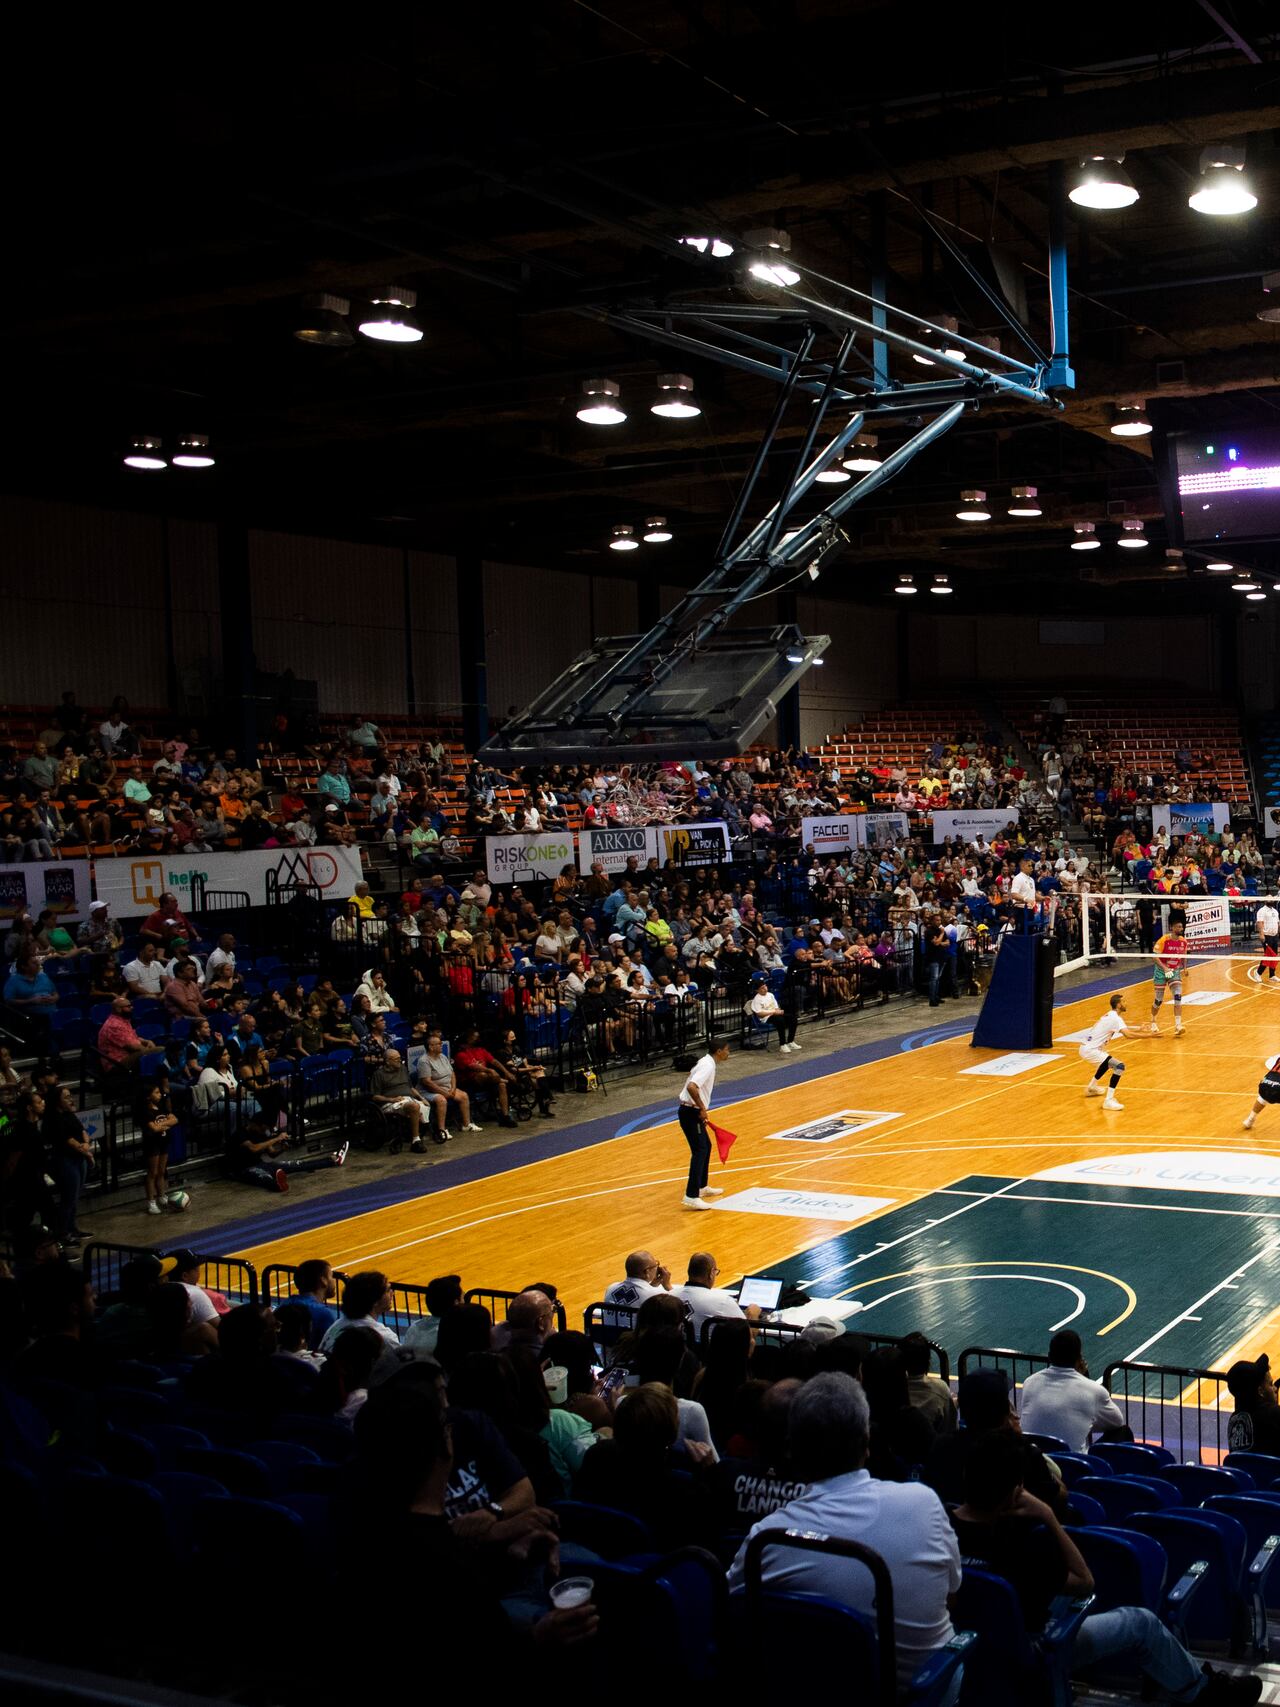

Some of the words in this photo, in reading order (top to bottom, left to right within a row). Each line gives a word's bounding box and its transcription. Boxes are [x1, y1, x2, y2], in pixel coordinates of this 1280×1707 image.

[691, 830, 703, 840] VAN
[813, 825, 848, 837] FACCIO
[593, 831, 645, 851] ARKYO
[494, 845, 557, 863] RISKONE
[494, 863, 529, 871] GROUP
[772, 1194, 854, 1209] Midea
